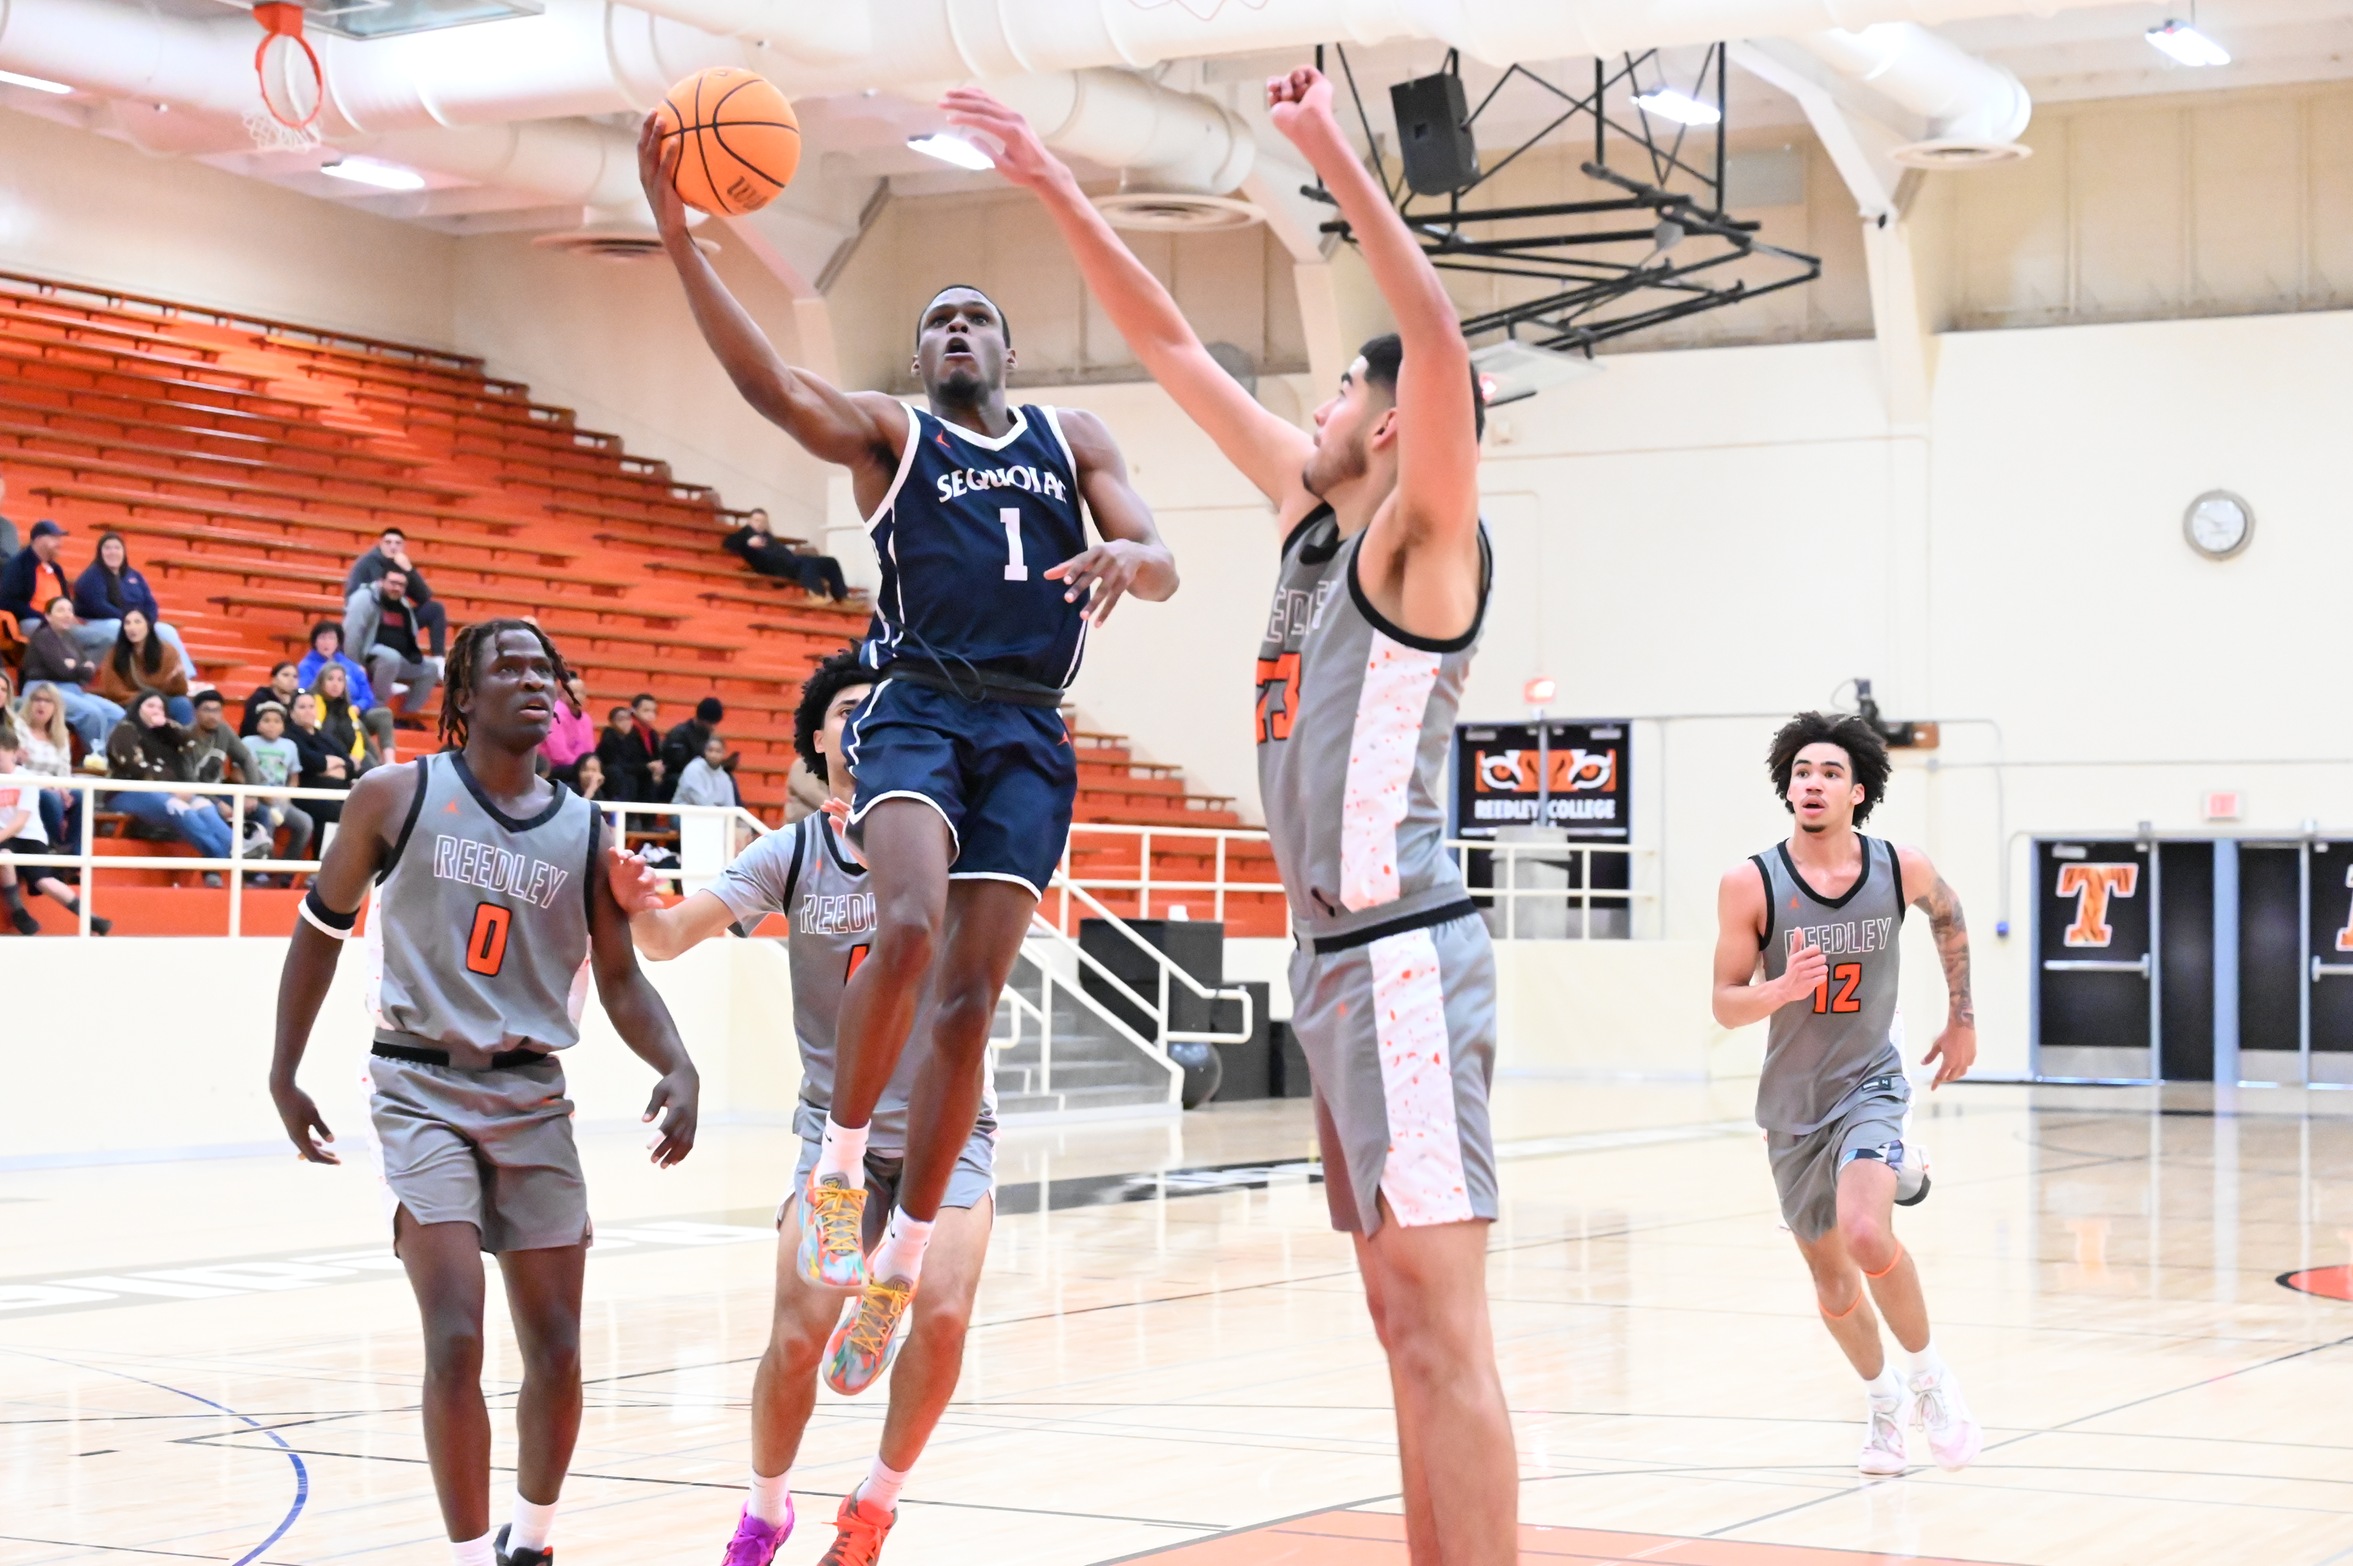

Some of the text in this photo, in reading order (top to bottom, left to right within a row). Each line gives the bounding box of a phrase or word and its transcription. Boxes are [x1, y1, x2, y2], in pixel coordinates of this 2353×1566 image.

[1000, 508, 1028, 581] 1
[1474, 799, 1616, 820] REEDLEY COLLEGE
[434, 834, 569, 909] REEDLEY
[2056, 863, 2139, 948] T
[466, 901, 512, 978] 0
[1812, 962, 1863, 1014] 12
